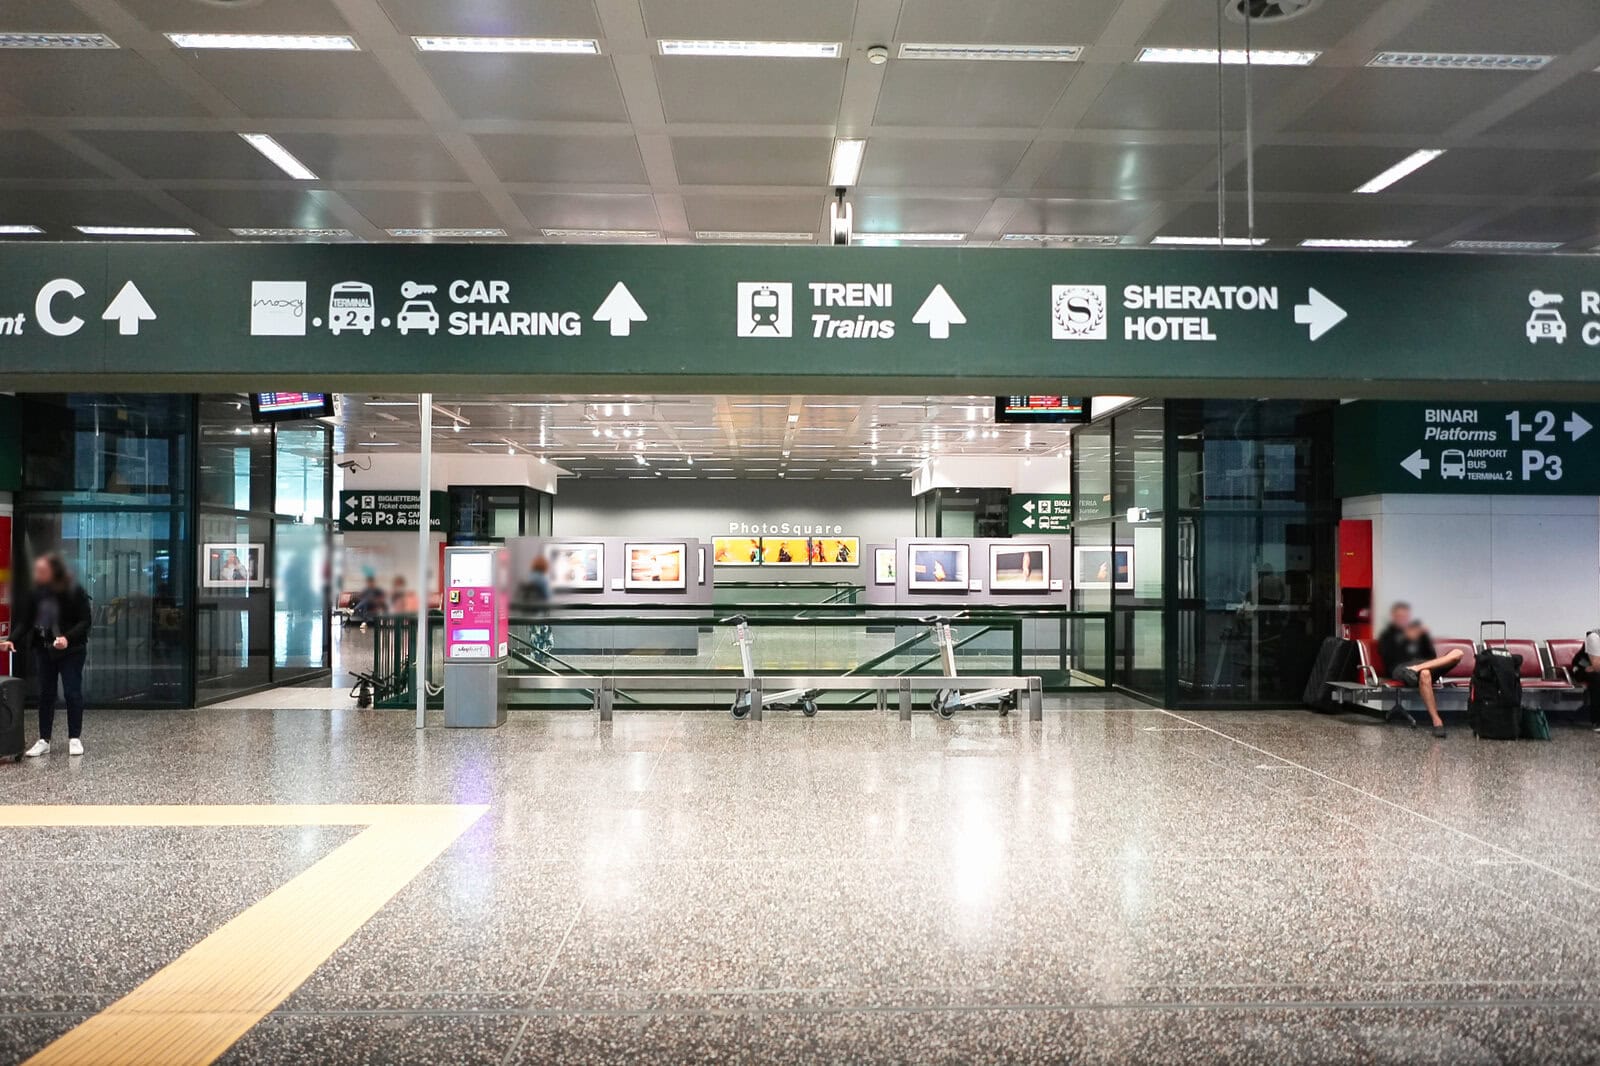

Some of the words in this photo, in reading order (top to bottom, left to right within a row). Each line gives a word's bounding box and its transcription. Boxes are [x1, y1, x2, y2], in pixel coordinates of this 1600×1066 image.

[448, 280, 510, 304] CAR
[808, 282, 893, 307] TRENI
[1122, 285, 1279, 310] SHERATON
[35, 278, 86, 336] C
[333, 298, 371, 308] TERMINAL
[346, 310, 357, 327] 2
[447, 312, 582, 337] SHARING
[811, 314, 896, 339] Trains
[1124, 316, 1217, 341] HOTEL
[1541, 322, 1552, 335] B
[1425, 409, 1478, 423] BINARI
[1424, 427, 1497, 441] Platforms
[1505, 410, 1556, 442] 1-2
[1466, 449, 1508, 458] AIRPORT
[1467, 460, 1487, 469] BUS
[1521, 450, 1563, 481] P3
[1467, 472, 1504, 481] TERMINAL
[1505, 470, 1513, 481] 2
[375, 511, 394, 525] P3
[729, 522, 843, 536] PhotoSquare
